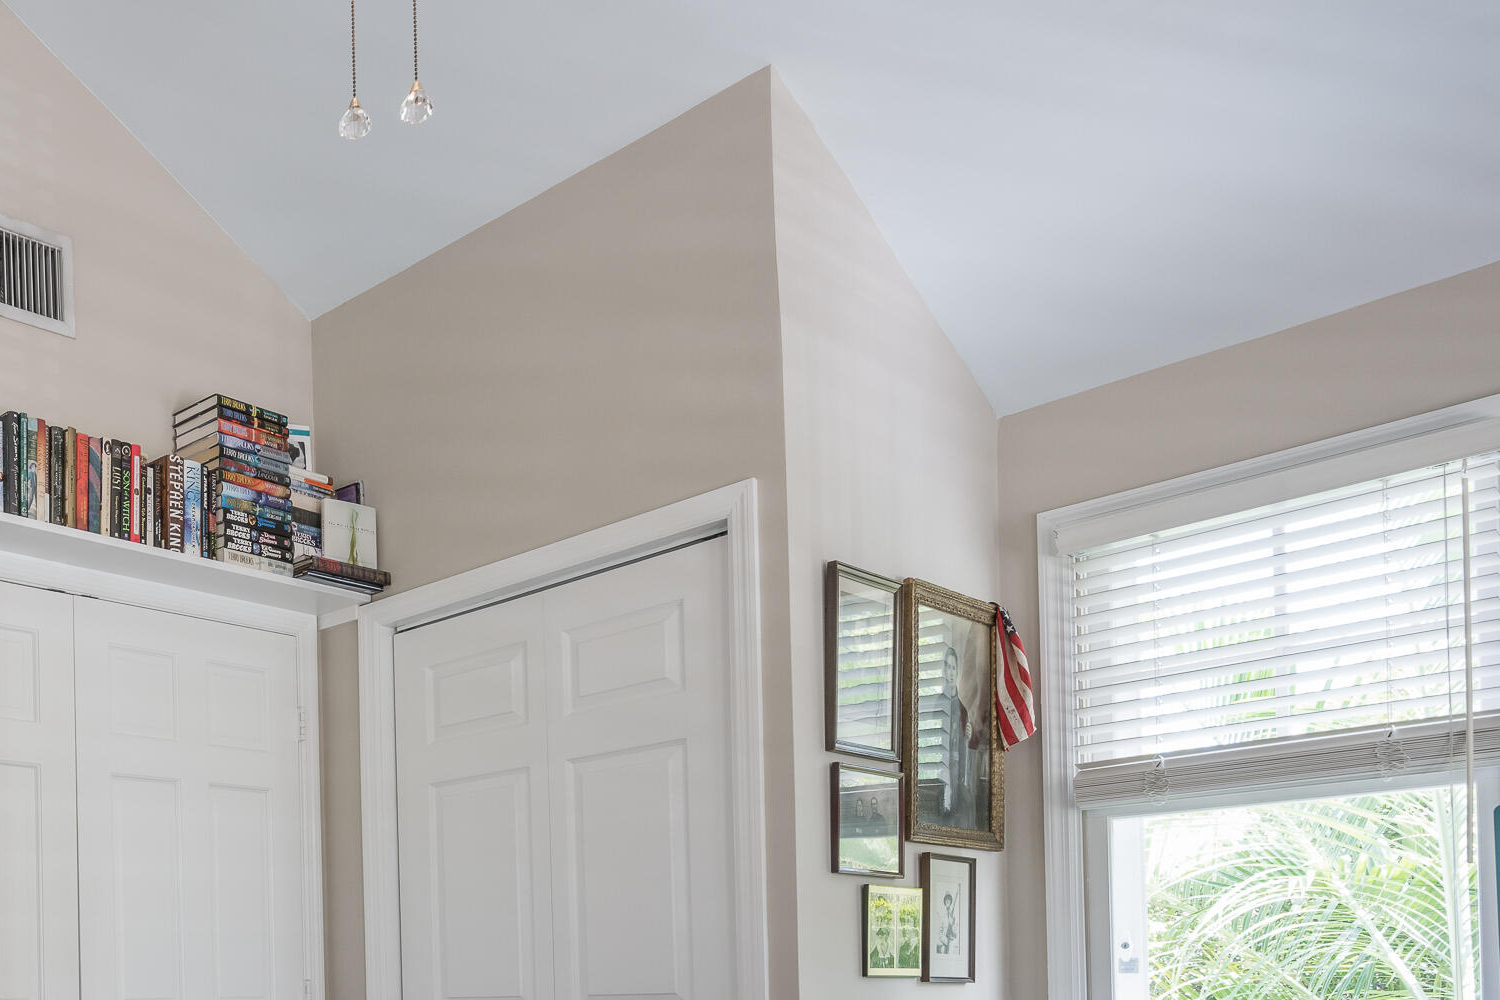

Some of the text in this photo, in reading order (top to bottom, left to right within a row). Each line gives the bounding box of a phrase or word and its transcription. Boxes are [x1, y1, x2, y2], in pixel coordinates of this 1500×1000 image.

[169, 454, 181, 519] STEPHEN
[226, 513, 249, 524] BROOKS
[231, 509, 249, 519] TERRY
[226, 528, 251, 540] BROOKS
[231, 523, 251, 534] TERRY
[232, 536, 253, 547] TERRY
[227, 541, 252, 554] BROOKS
